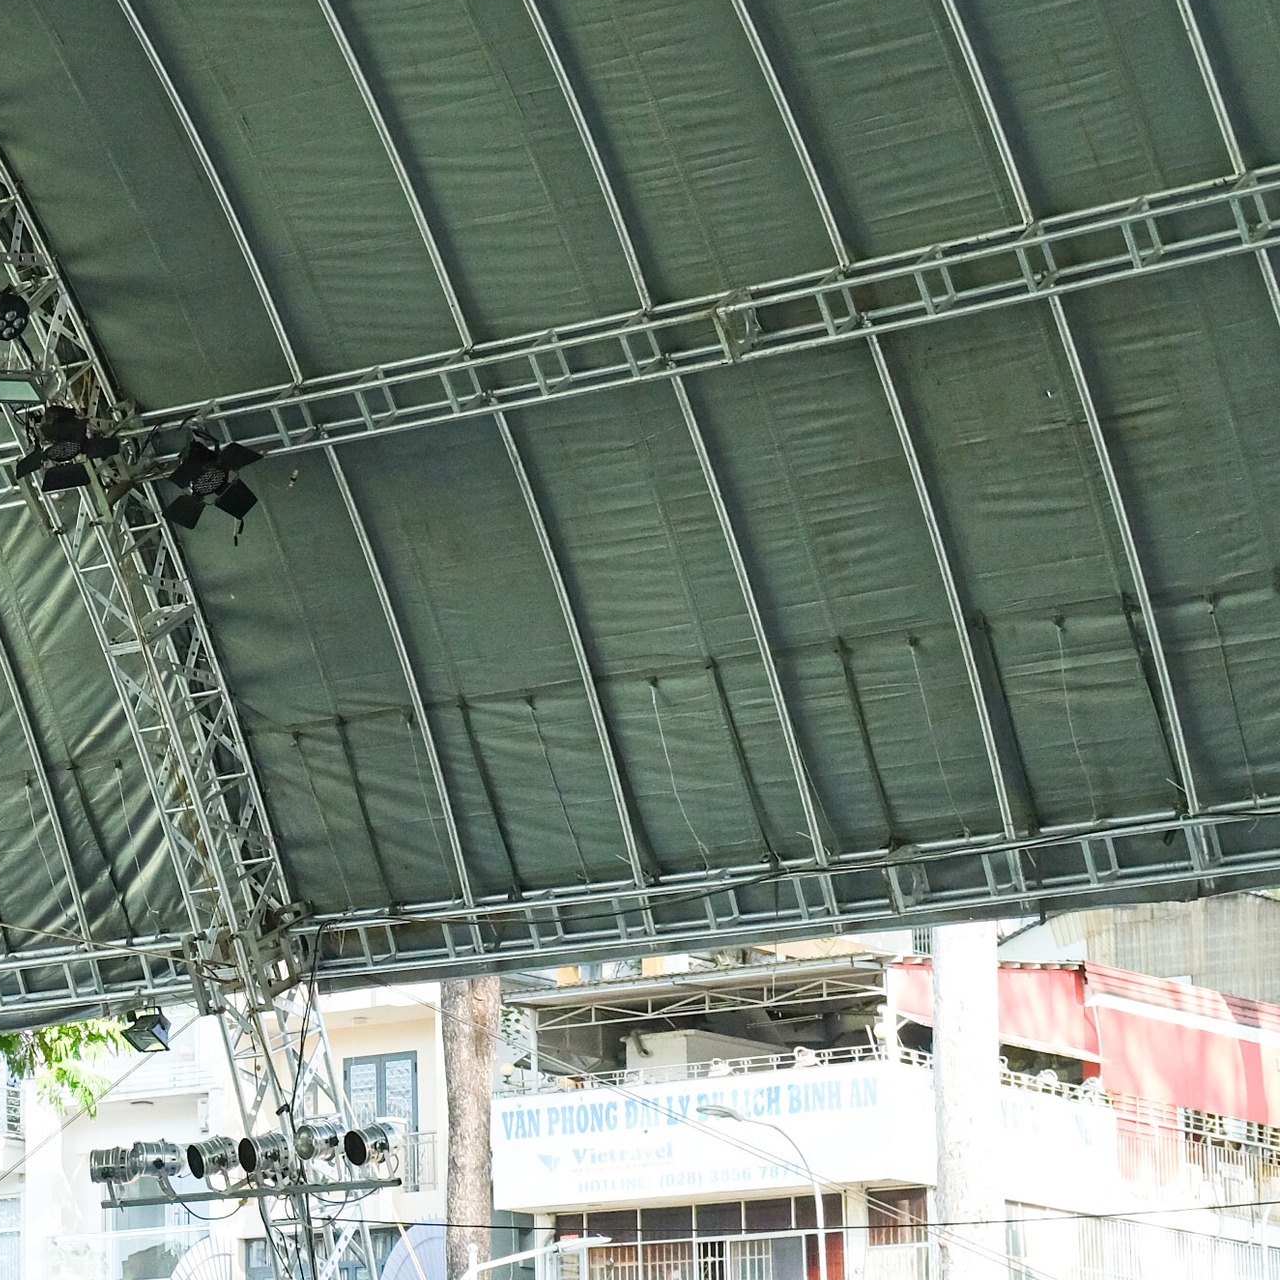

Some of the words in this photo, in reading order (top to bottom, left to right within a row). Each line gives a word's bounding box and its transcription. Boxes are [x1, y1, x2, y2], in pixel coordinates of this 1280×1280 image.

[501, 1103, 541, 1140] VĂN
[546, 1096, 618, 1137] PHÒNG
[849, 1076, 878, 1109] AN
[572, 1142, 673, 1166] Vietravel
[578, 1175, 653, 1195] HOTLINE:
[659, 1172, 704, 1190] (028)
[710, 1167, 752, 1184] 3856
